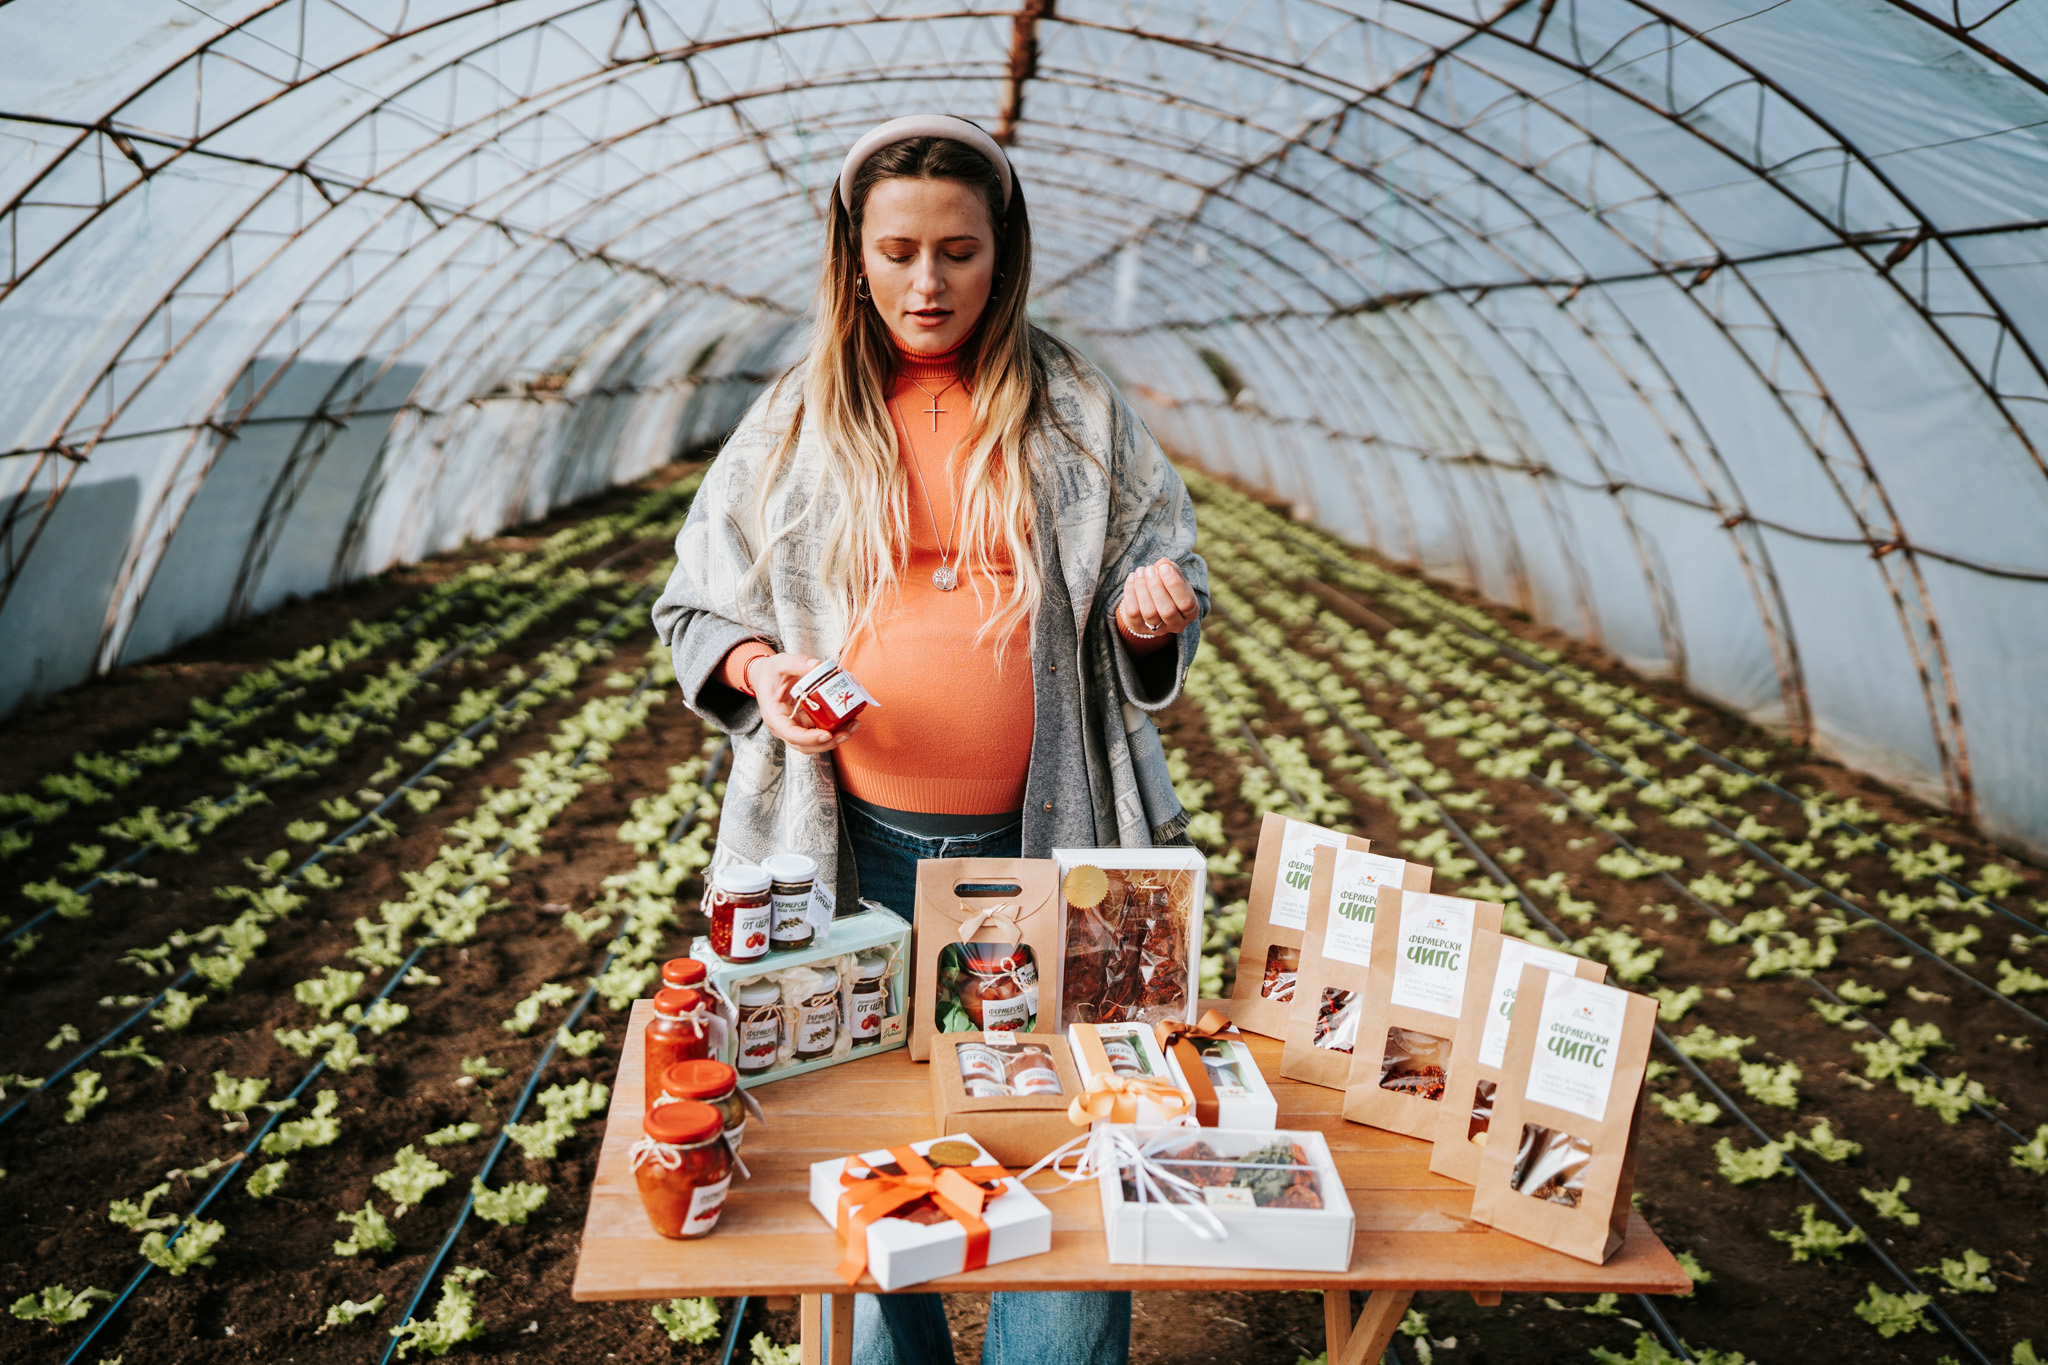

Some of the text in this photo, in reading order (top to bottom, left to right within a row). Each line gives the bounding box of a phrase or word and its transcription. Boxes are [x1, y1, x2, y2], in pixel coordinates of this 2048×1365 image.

[742, 921, 754, 930] ОТ
[1408, 934, 1462, 952] ФЕРМЕРСКИ
[1406, 945, 1461, 972] ЧИПС
[857, 1004, 868, 1013] ОТ
[988, 1003, 1024, 1014] ФЕРМЕРСКО
[1551, 1022, 1610, 1046] ФЕРМЕРСКИ
[1547, 1035, 1607, 1068] ЧИПС
